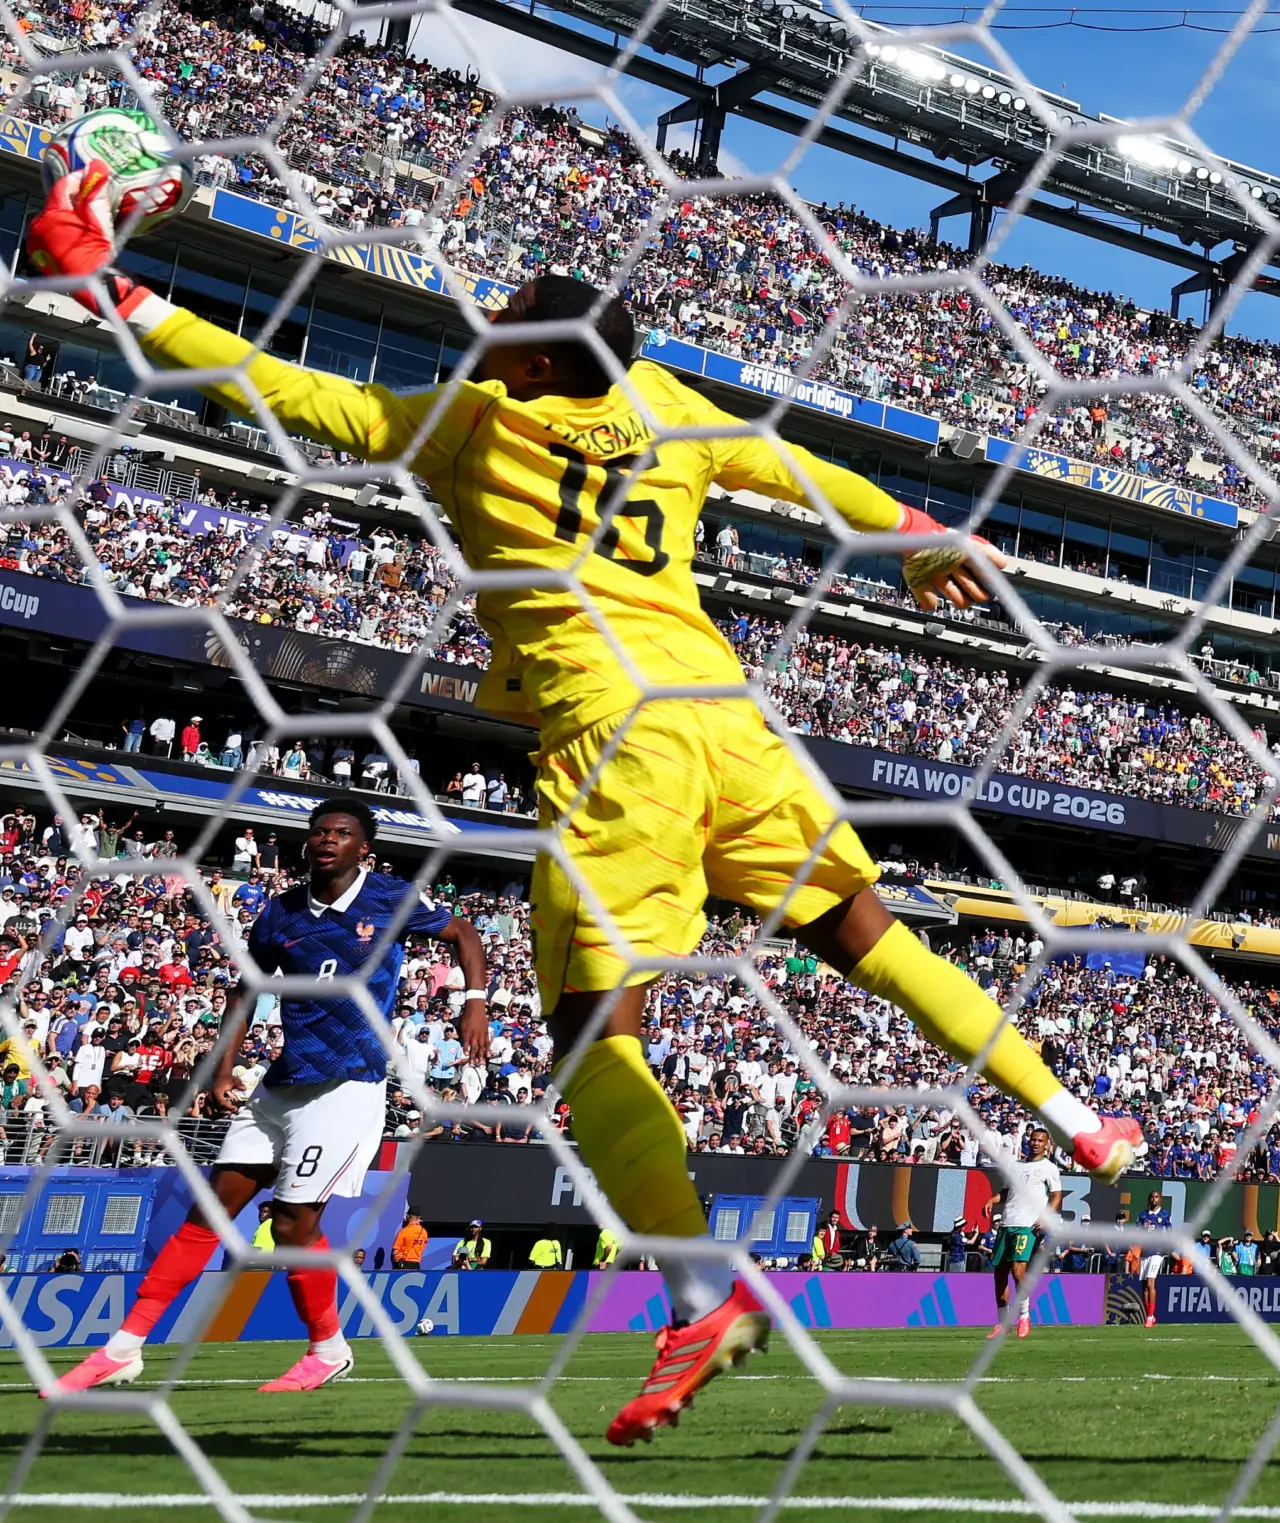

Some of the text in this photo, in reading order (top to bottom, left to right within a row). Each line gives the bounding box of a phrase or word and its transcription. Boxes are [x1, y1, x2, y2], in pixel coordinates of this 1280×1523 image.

[740, 364, 853, 417] #FIFAWorldCup
[548, 441, 670, 577] 16
[421, 672, 479, 703] NEW
[871, 759, 1125, 825] FIFA WORLD CUP 2026
[296, 1145, 323, 1178] 8
[1015, 1235, 1028, 1250] 13
[1168, 1286, 1212, 1312] FIFA
